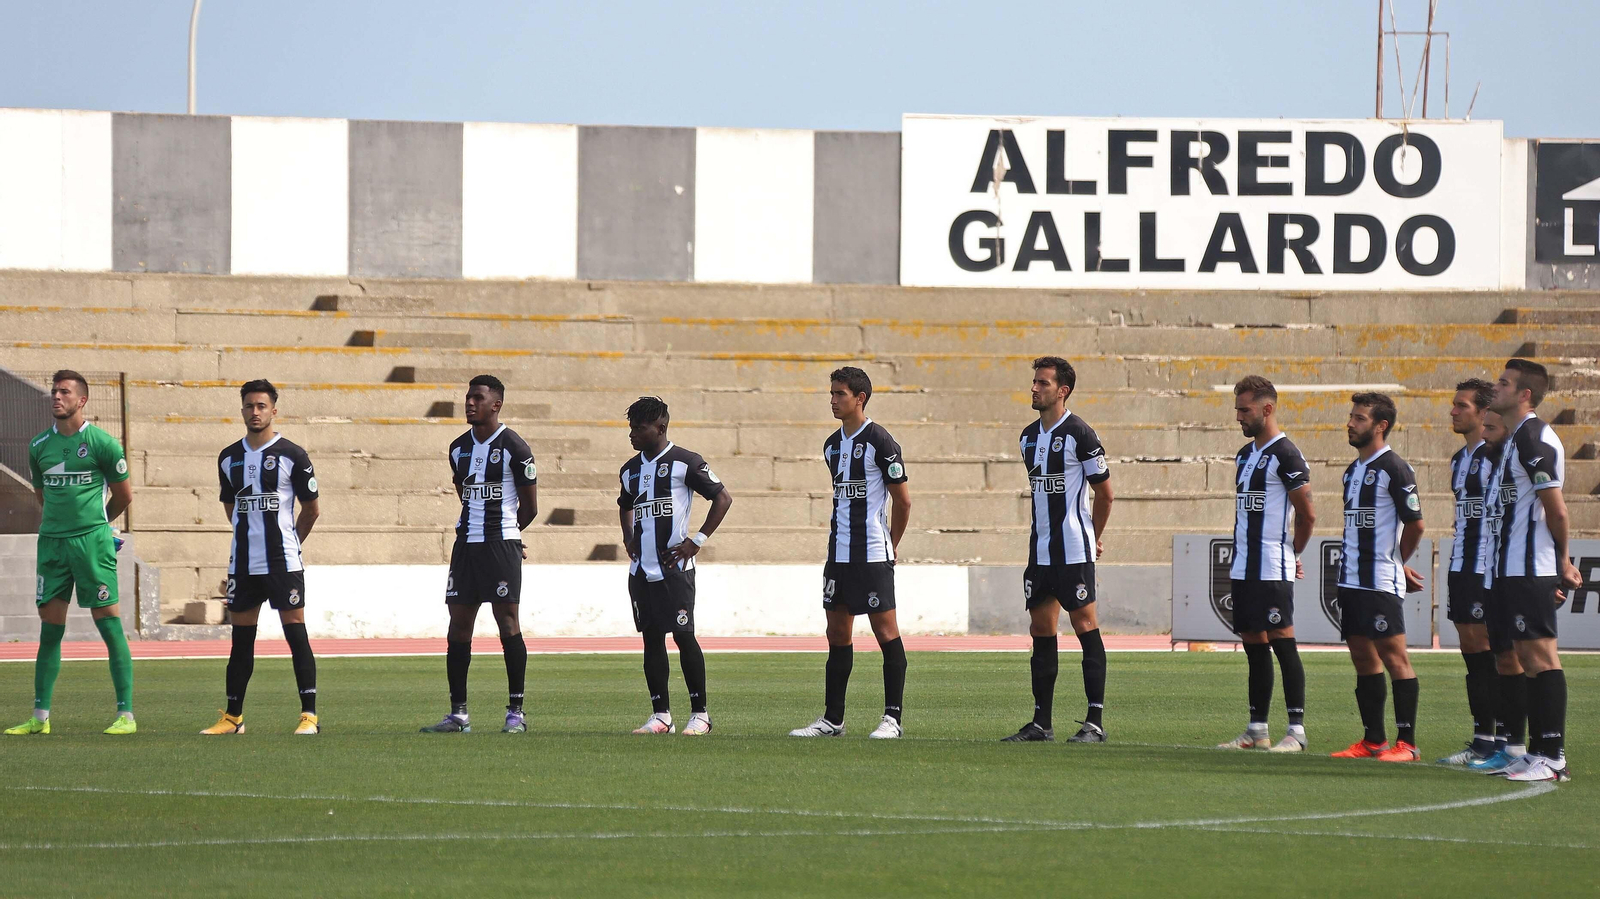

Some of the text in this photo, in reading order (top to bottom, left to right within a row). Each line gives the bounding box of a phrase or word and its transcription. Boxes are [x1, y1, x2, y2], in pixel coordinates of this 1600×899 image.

[970, 128, 1443, 198] ALFREDO
[947, 209, 1457, 277] GALLARDO
[1563, 206, 1600, 256] L
[1236, 494, 1267, 512] TUS
